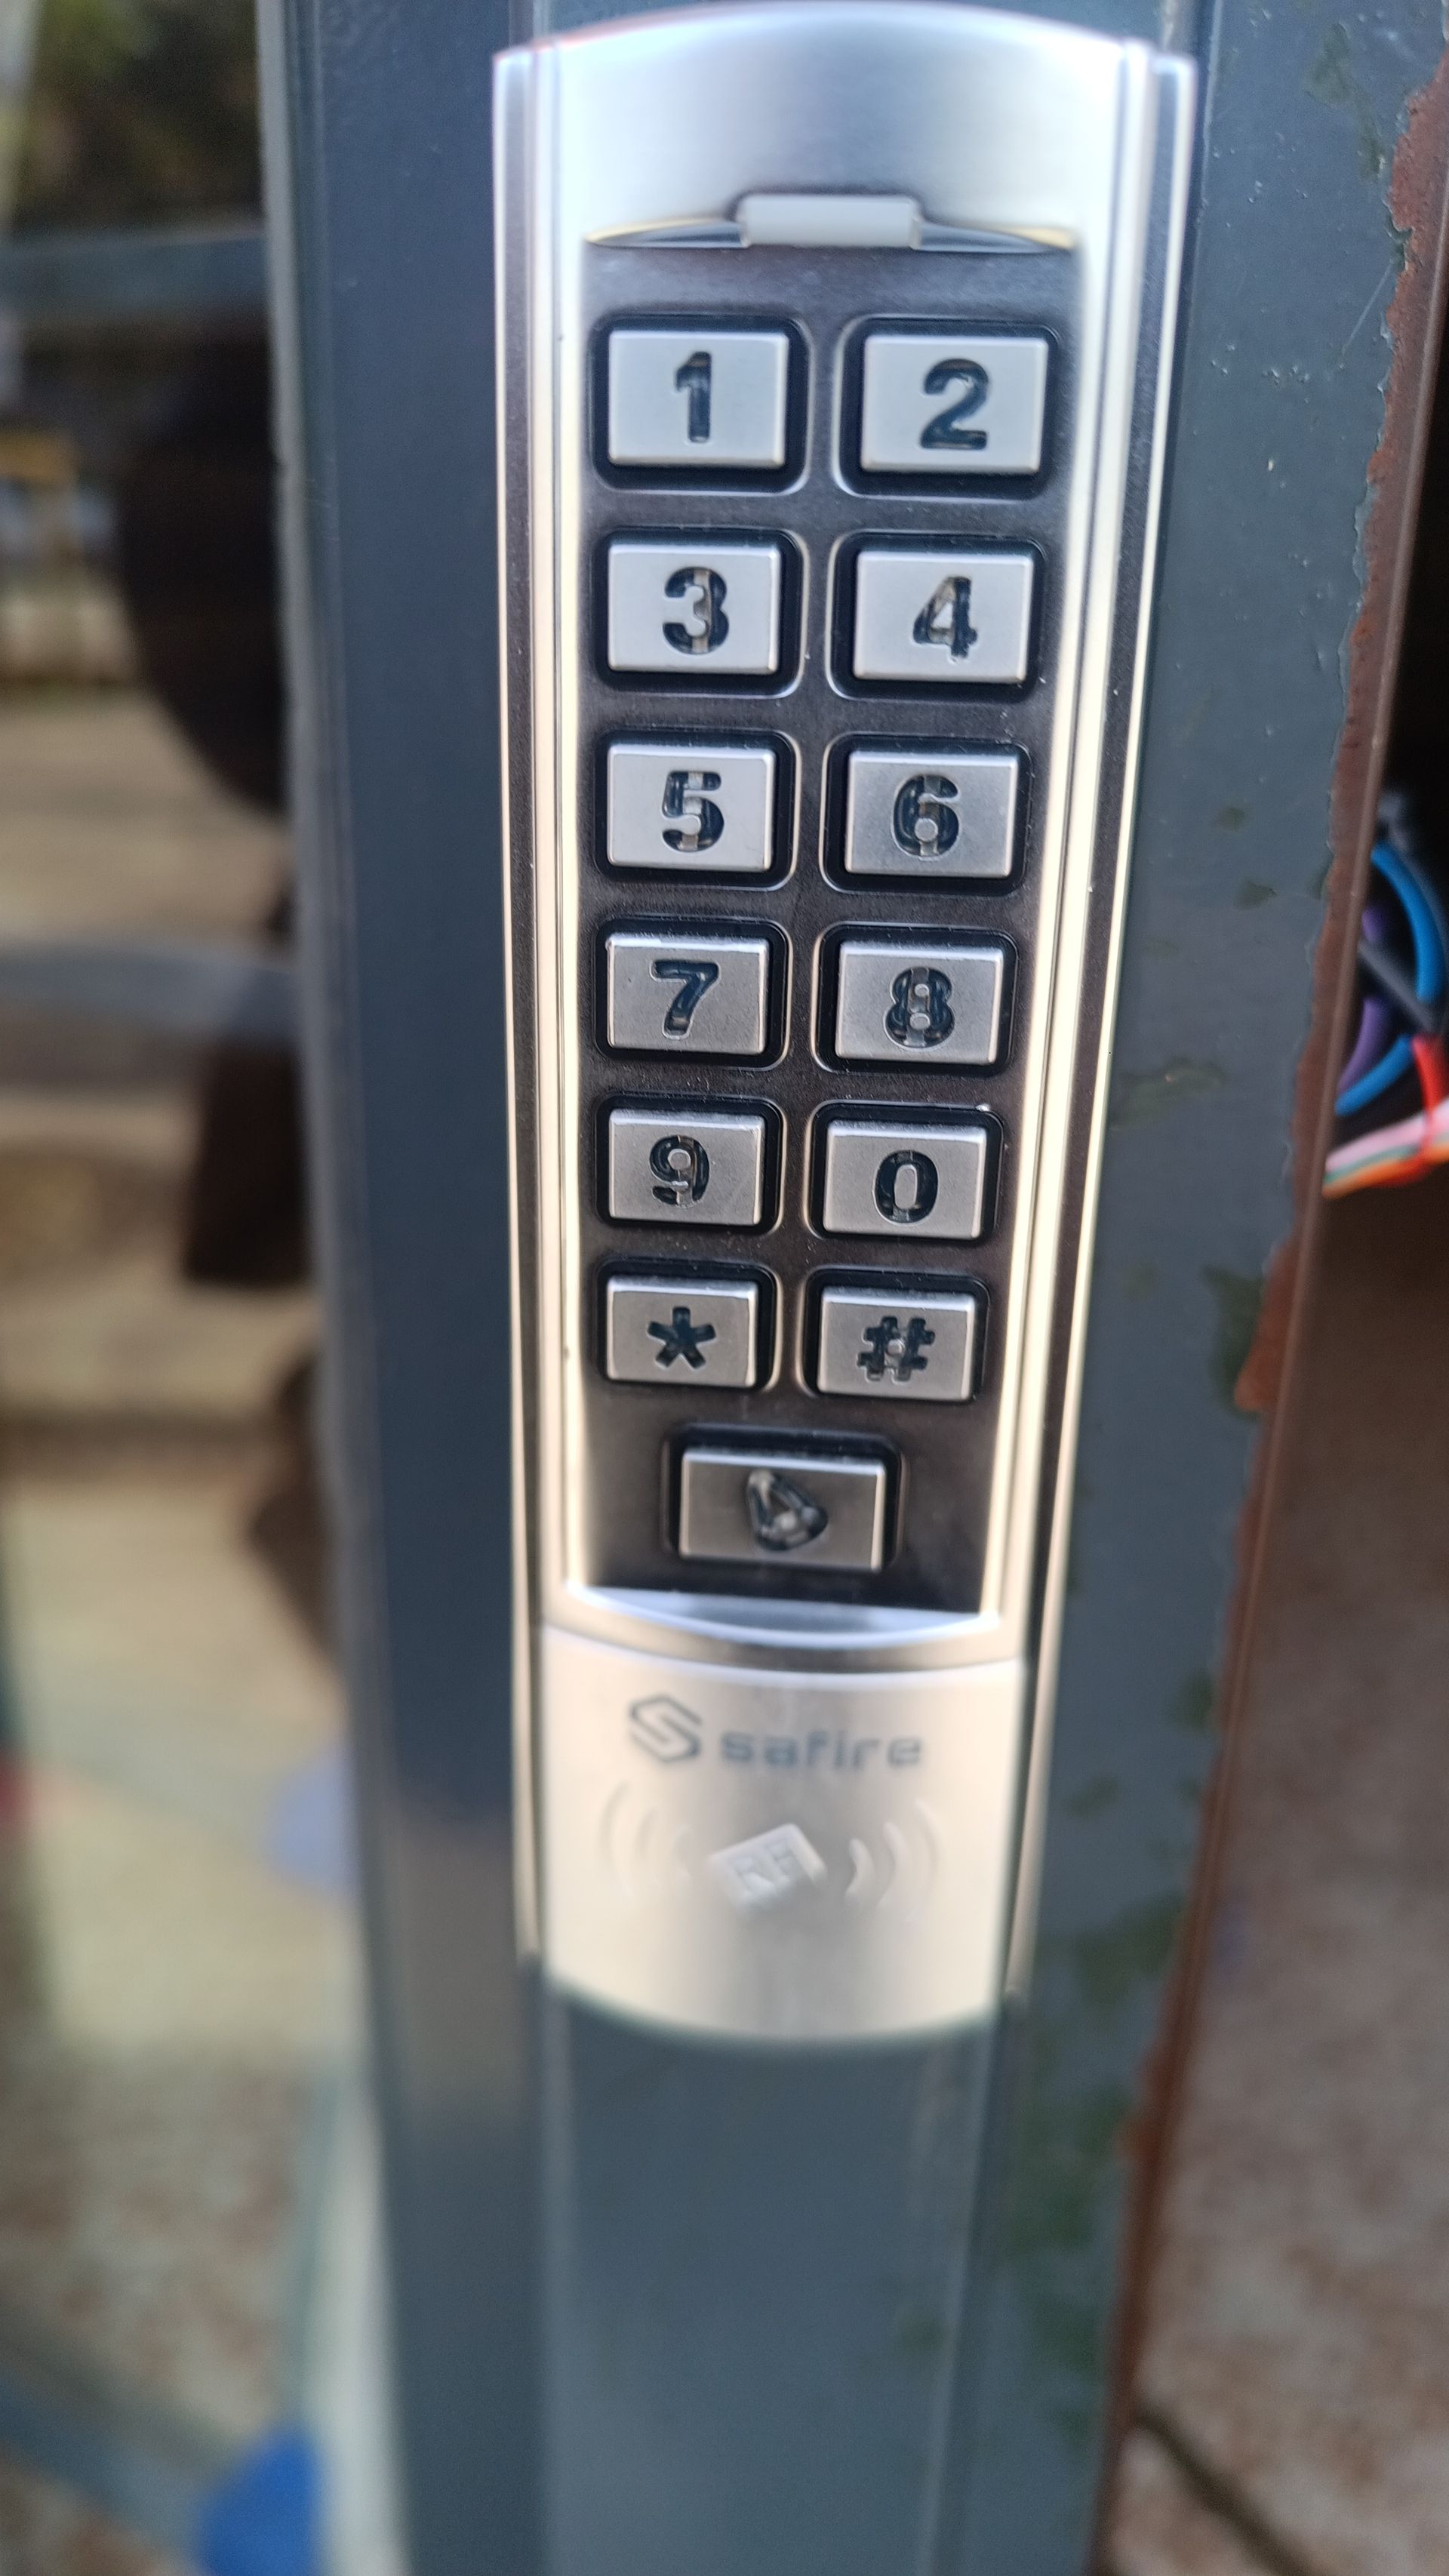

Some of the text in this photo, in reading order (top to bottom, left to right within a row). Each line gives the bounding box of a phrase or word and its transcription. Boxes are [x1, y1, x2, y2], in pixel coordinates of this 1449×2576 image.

[675, 351, 712, 443] 1
[919, 358, 990, 450] 2
[663, 567, 729, 654] 3
[912, 576, 978, 660] 4
[661, 771, 724, 852] 5
[891, 774, 960, 860] 6
[650, 959, 719, 1039] 7
[883, 966, 955, 1048] 8
[649, 1134, 710, 1206] 9
[872, 1149, 939, 1223] 0
[719, 1729, 924, 1770] safire
